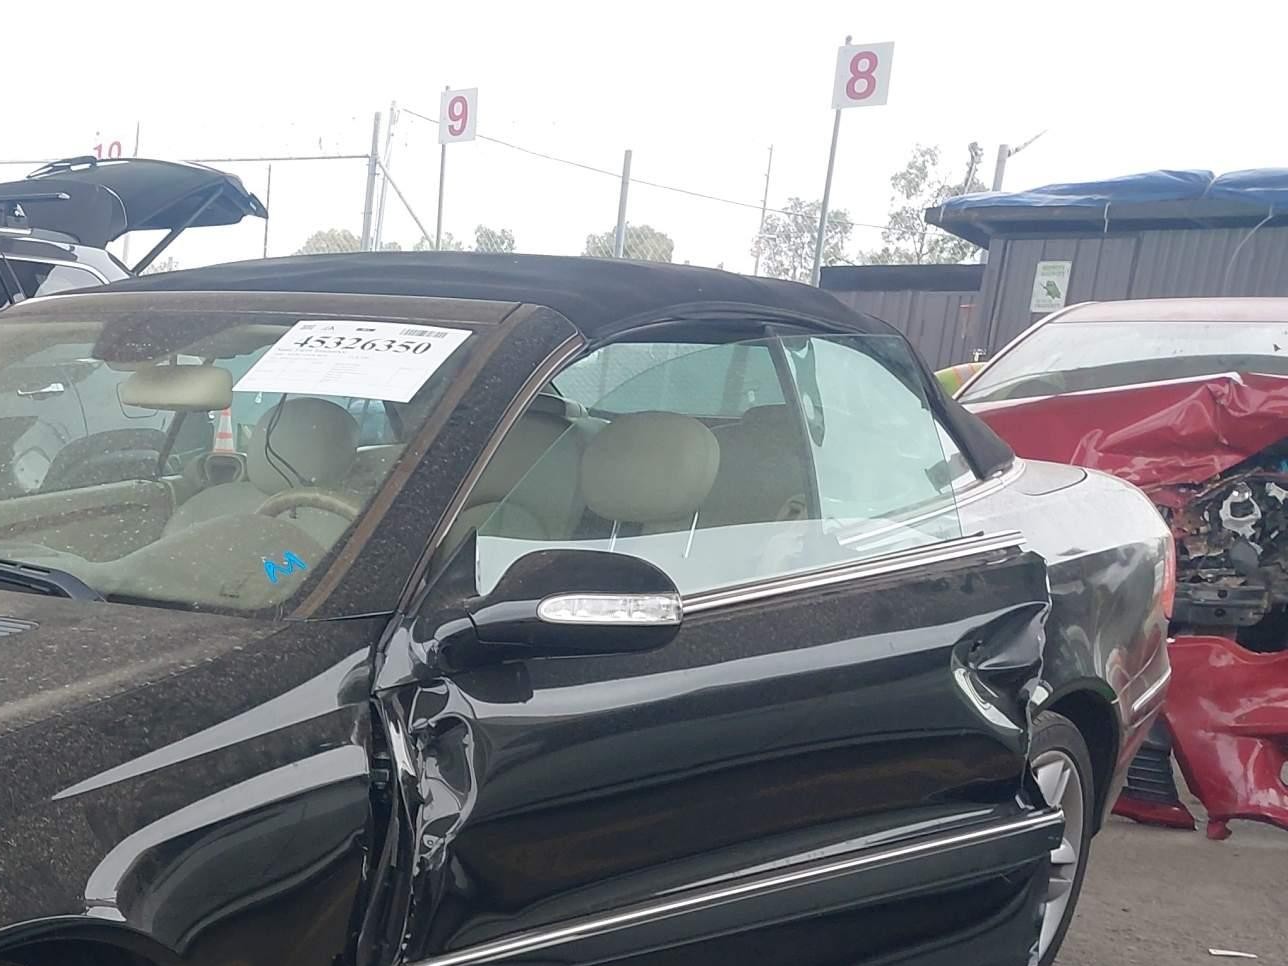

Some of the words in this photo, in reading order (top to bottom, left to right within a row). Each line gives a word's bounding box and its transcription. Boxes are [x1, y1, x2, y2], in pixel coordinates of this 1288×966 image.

[846, 51, 878, 100] 8
[448, 96, 468, 136] 9
[294, 335, 432, 354] 45326350
